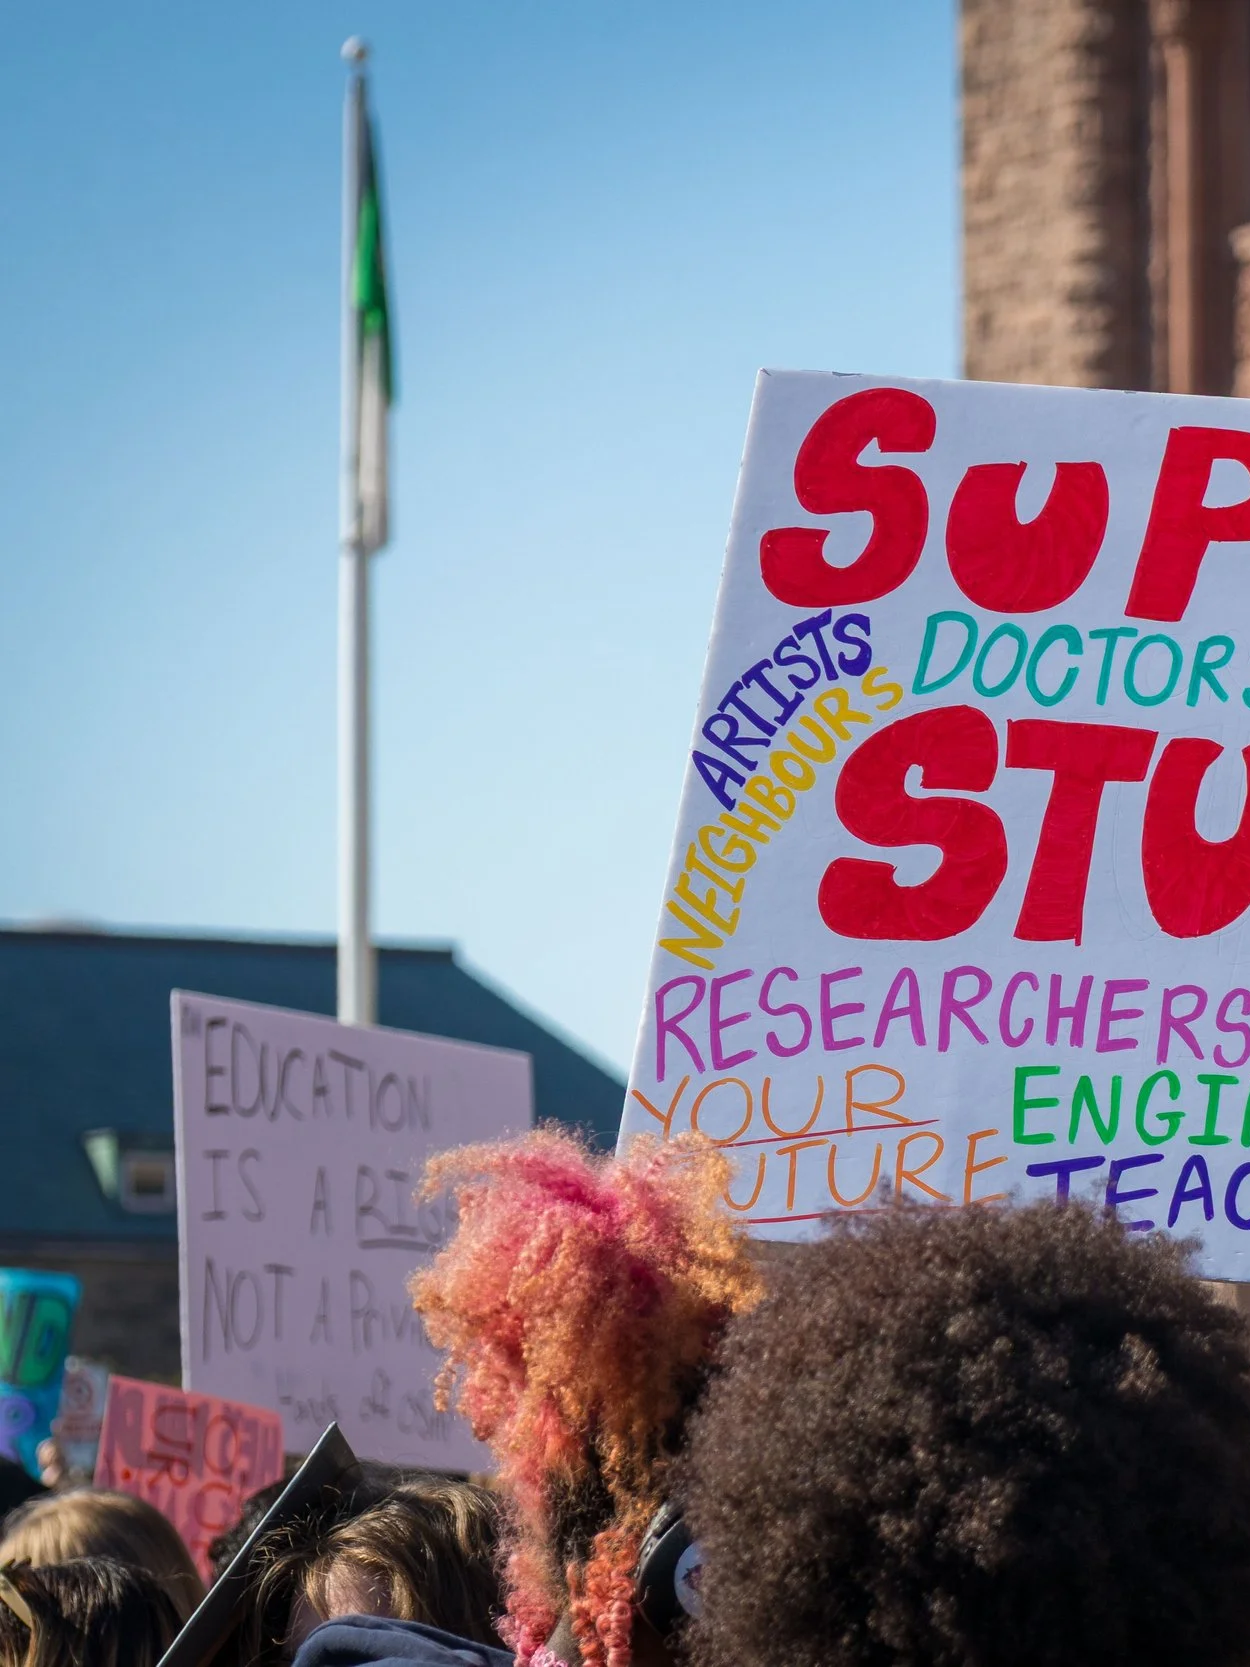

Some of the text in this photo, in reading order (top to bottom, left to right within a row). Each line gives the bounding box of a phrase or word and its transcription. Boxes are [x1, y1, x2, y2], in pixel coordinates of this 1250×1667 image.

[692, 608, 872, 811] ARTISTS
[659, 666, 903, 970] NEIGHBOURS
[204, 1015, 434, 1134] EDUCATION
[631, 1063, 915, 1147] YOUR
[203, 1149, 265, 1222] IS
[310, 1165, 335, 1237] A
[720, 1128, 1009, 1211] UTURE
[203, 1254, 295, 1364] NOT
[309, 1275, 333, 1346] A
